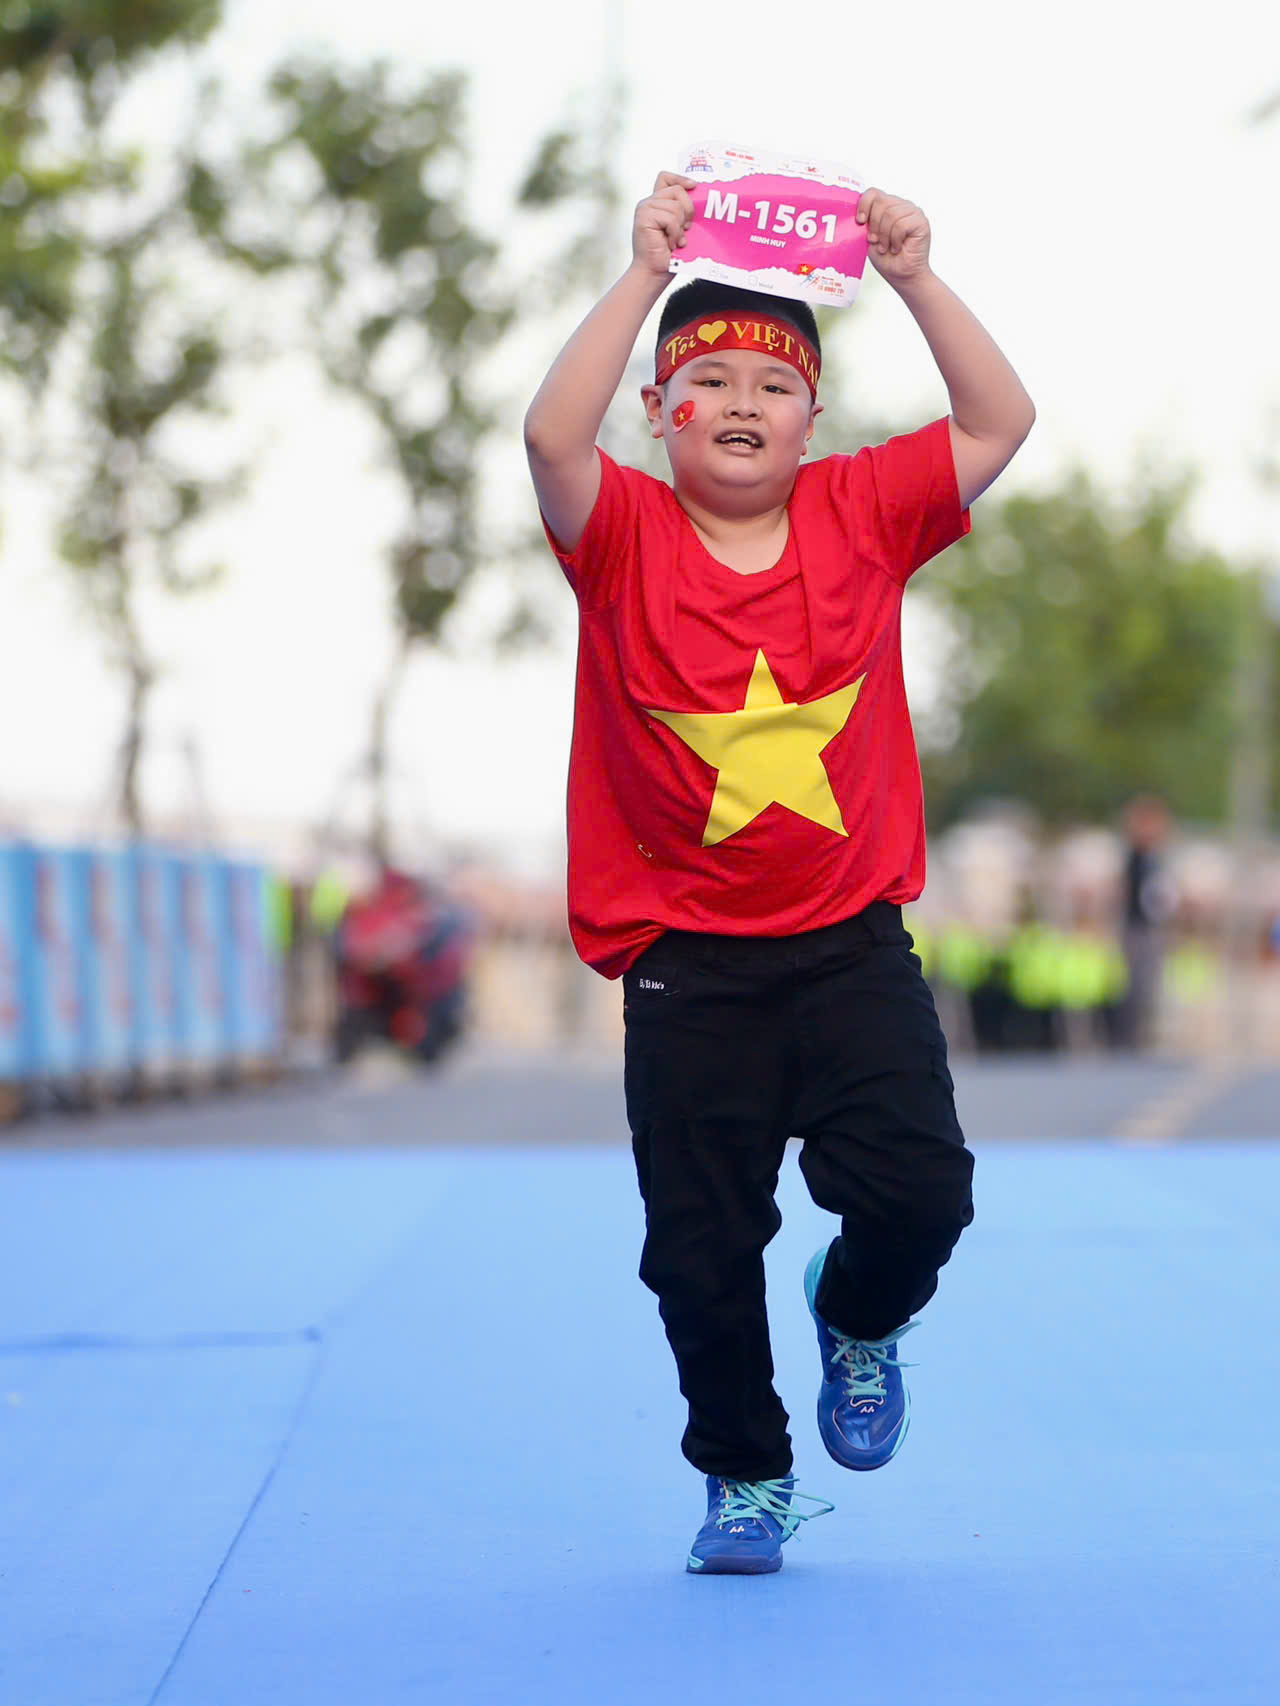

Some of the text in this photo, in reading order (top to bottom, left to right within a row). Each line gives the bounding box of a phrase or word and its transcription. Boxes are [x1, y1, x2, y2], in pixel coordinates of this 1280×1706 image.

[703, 189, 838, 243] M-1561
[750, 235, 786, 248] MINH HUY
[666, 332, 697, 366] Tôi
[729, 321, 795, 355] VIỆT
